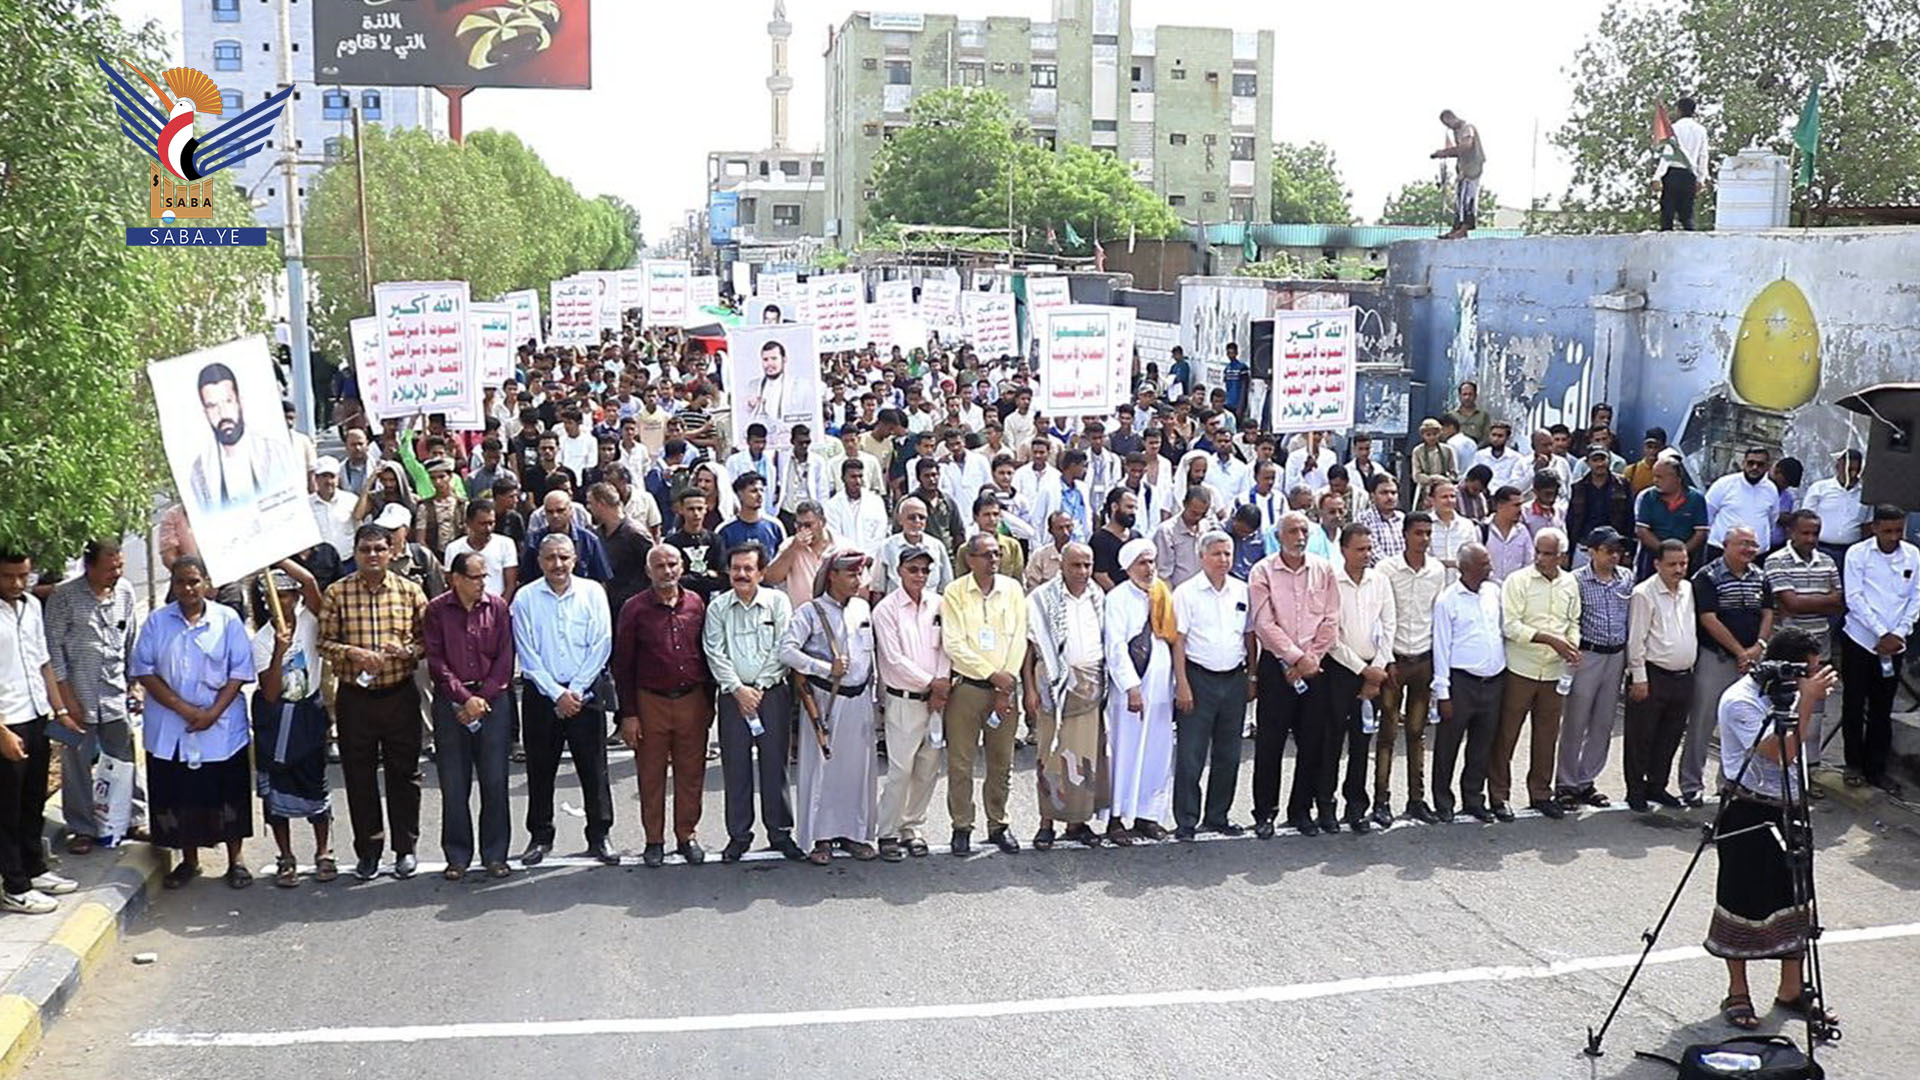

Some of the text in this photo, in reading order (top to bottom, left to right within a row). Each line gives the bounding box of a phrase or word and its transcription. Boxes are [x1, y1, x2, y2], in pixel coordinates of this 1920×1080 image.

[337, 33, 426, 60] التي لا تقاوم
